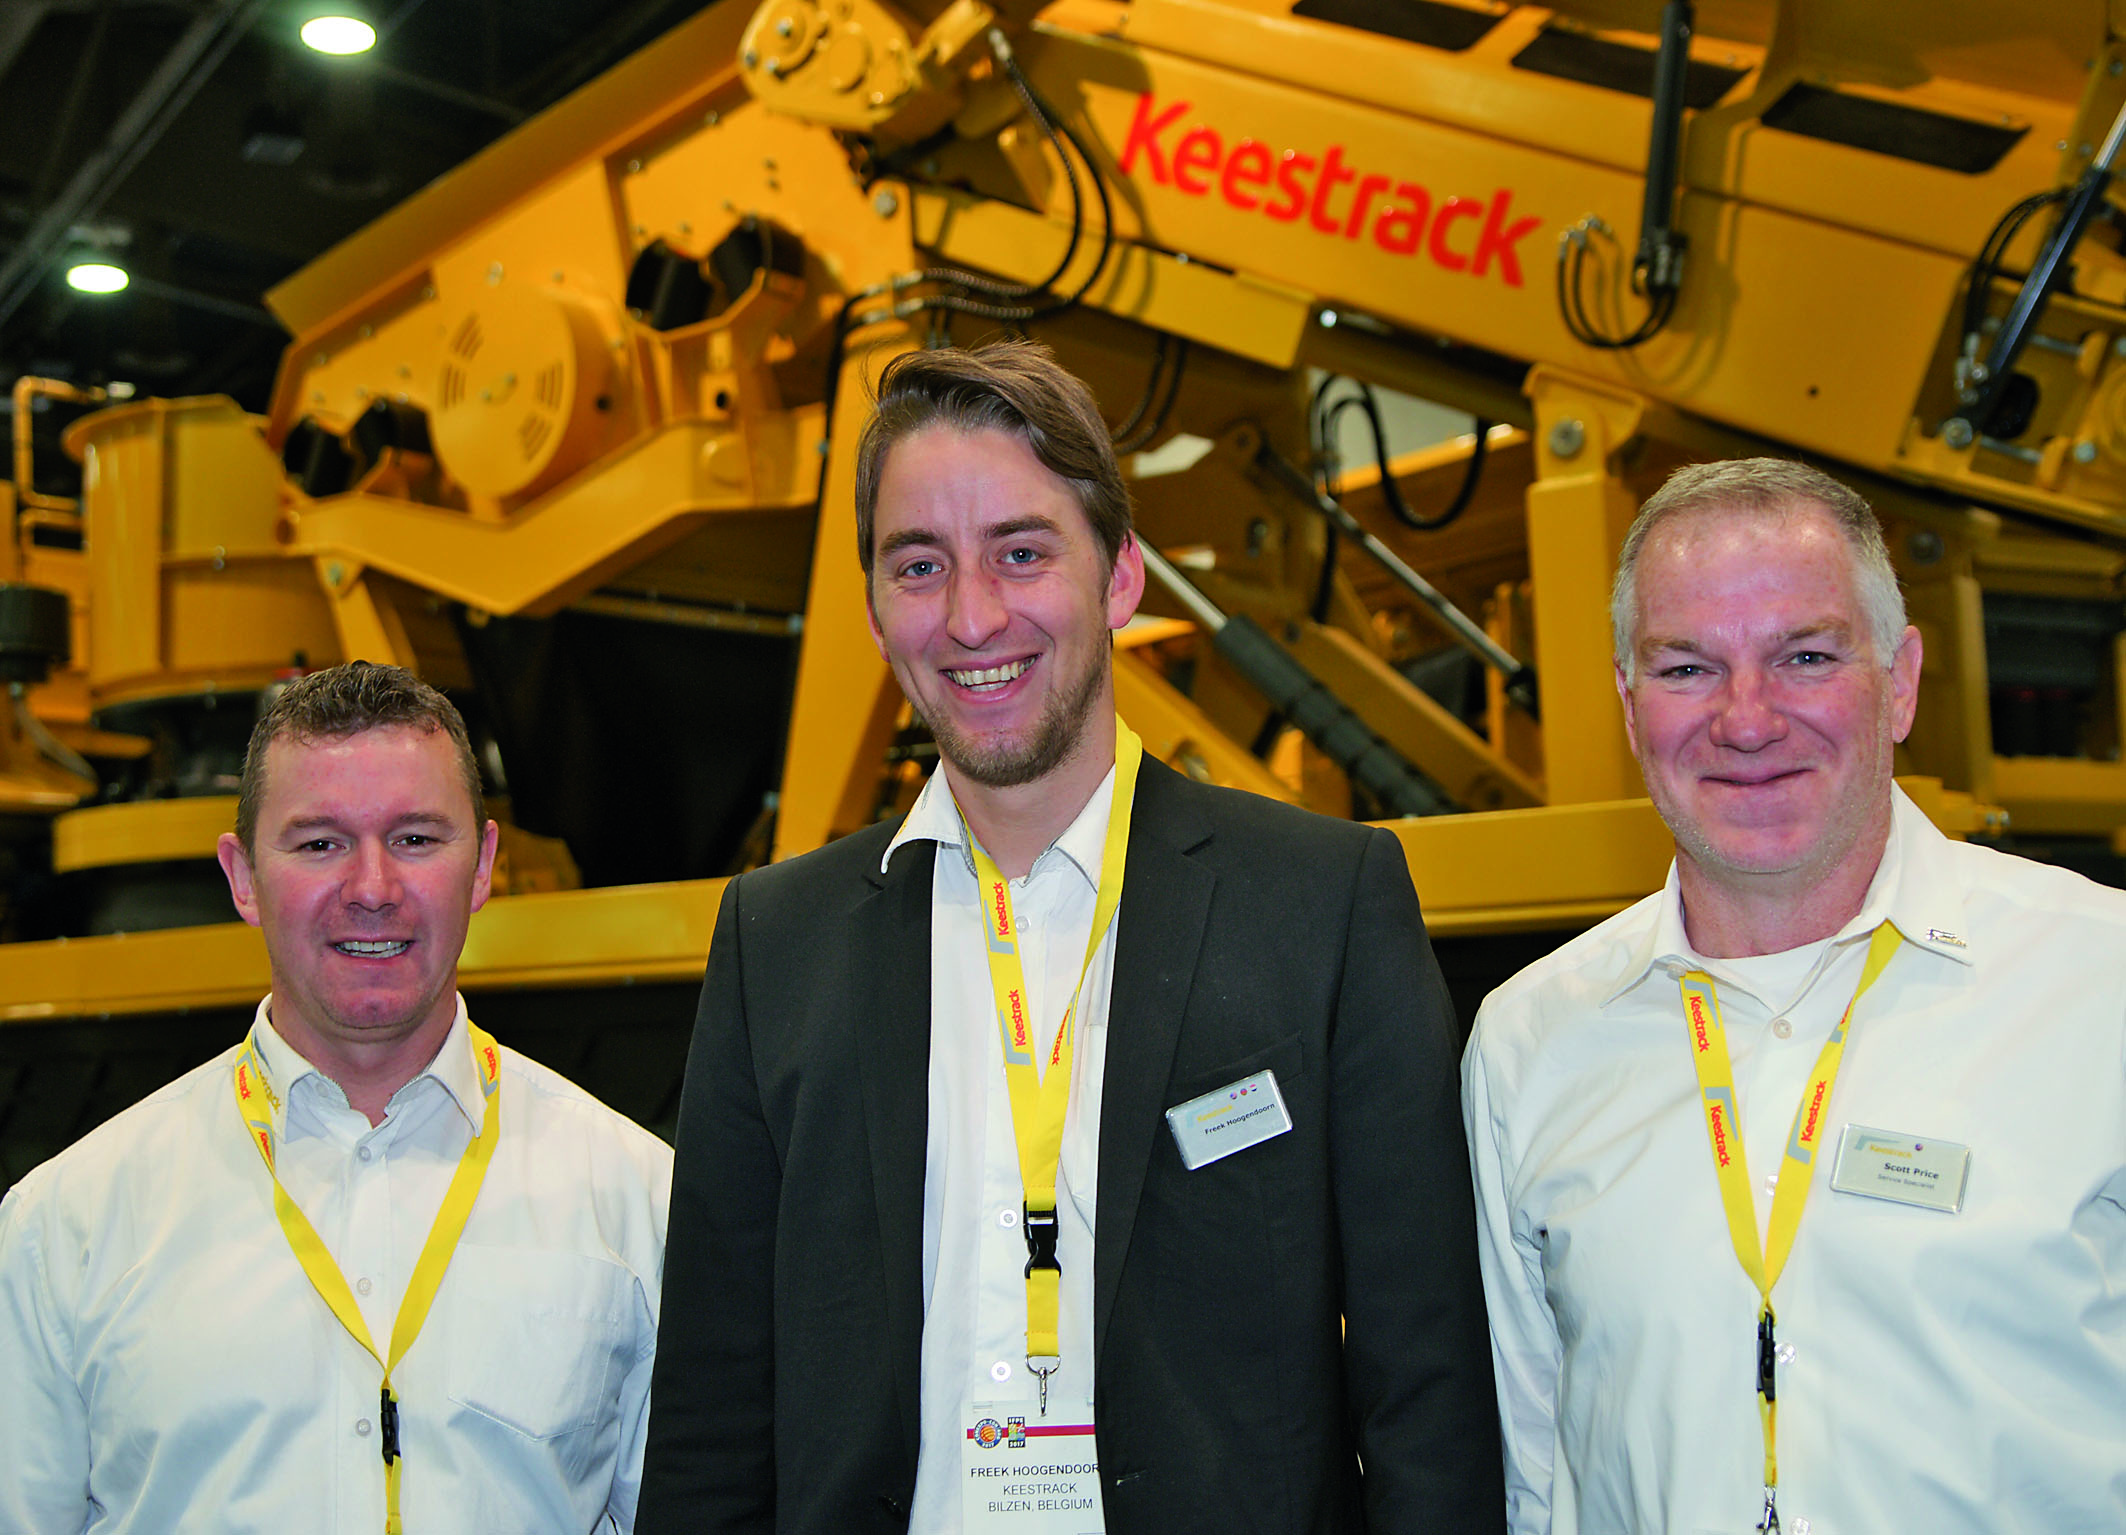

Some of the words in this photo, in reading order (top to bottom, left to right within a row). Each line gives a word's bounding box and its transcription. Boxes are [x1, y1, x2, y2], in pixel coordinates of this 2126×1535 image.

[1119, 91, 1543, 288] Keestrack
[992, 881, 1010, 936] Keestrack
[1009, 988, 1027, 1047] Keestrack
[1688, 995, 1711, 1053] Keestrack
[1204, 1123, 1226, 1135] Freek
[1226, 1103, 1275, 1126] Hoogendoorn
[1709, 1104, 1731, 1168] Keestrack
[1800, 1080, 1827, 1142] Keestrack
[1884, 1162, 1911, 1174] Scott
[1913, 1168, 1940, 1180] Price
[970, 1467, 1009, 1478] FREEK
[1003, 1483, 1078, 1496] KEESTRACK
[1037, 1498, 1093, 1511] BELGIUM
